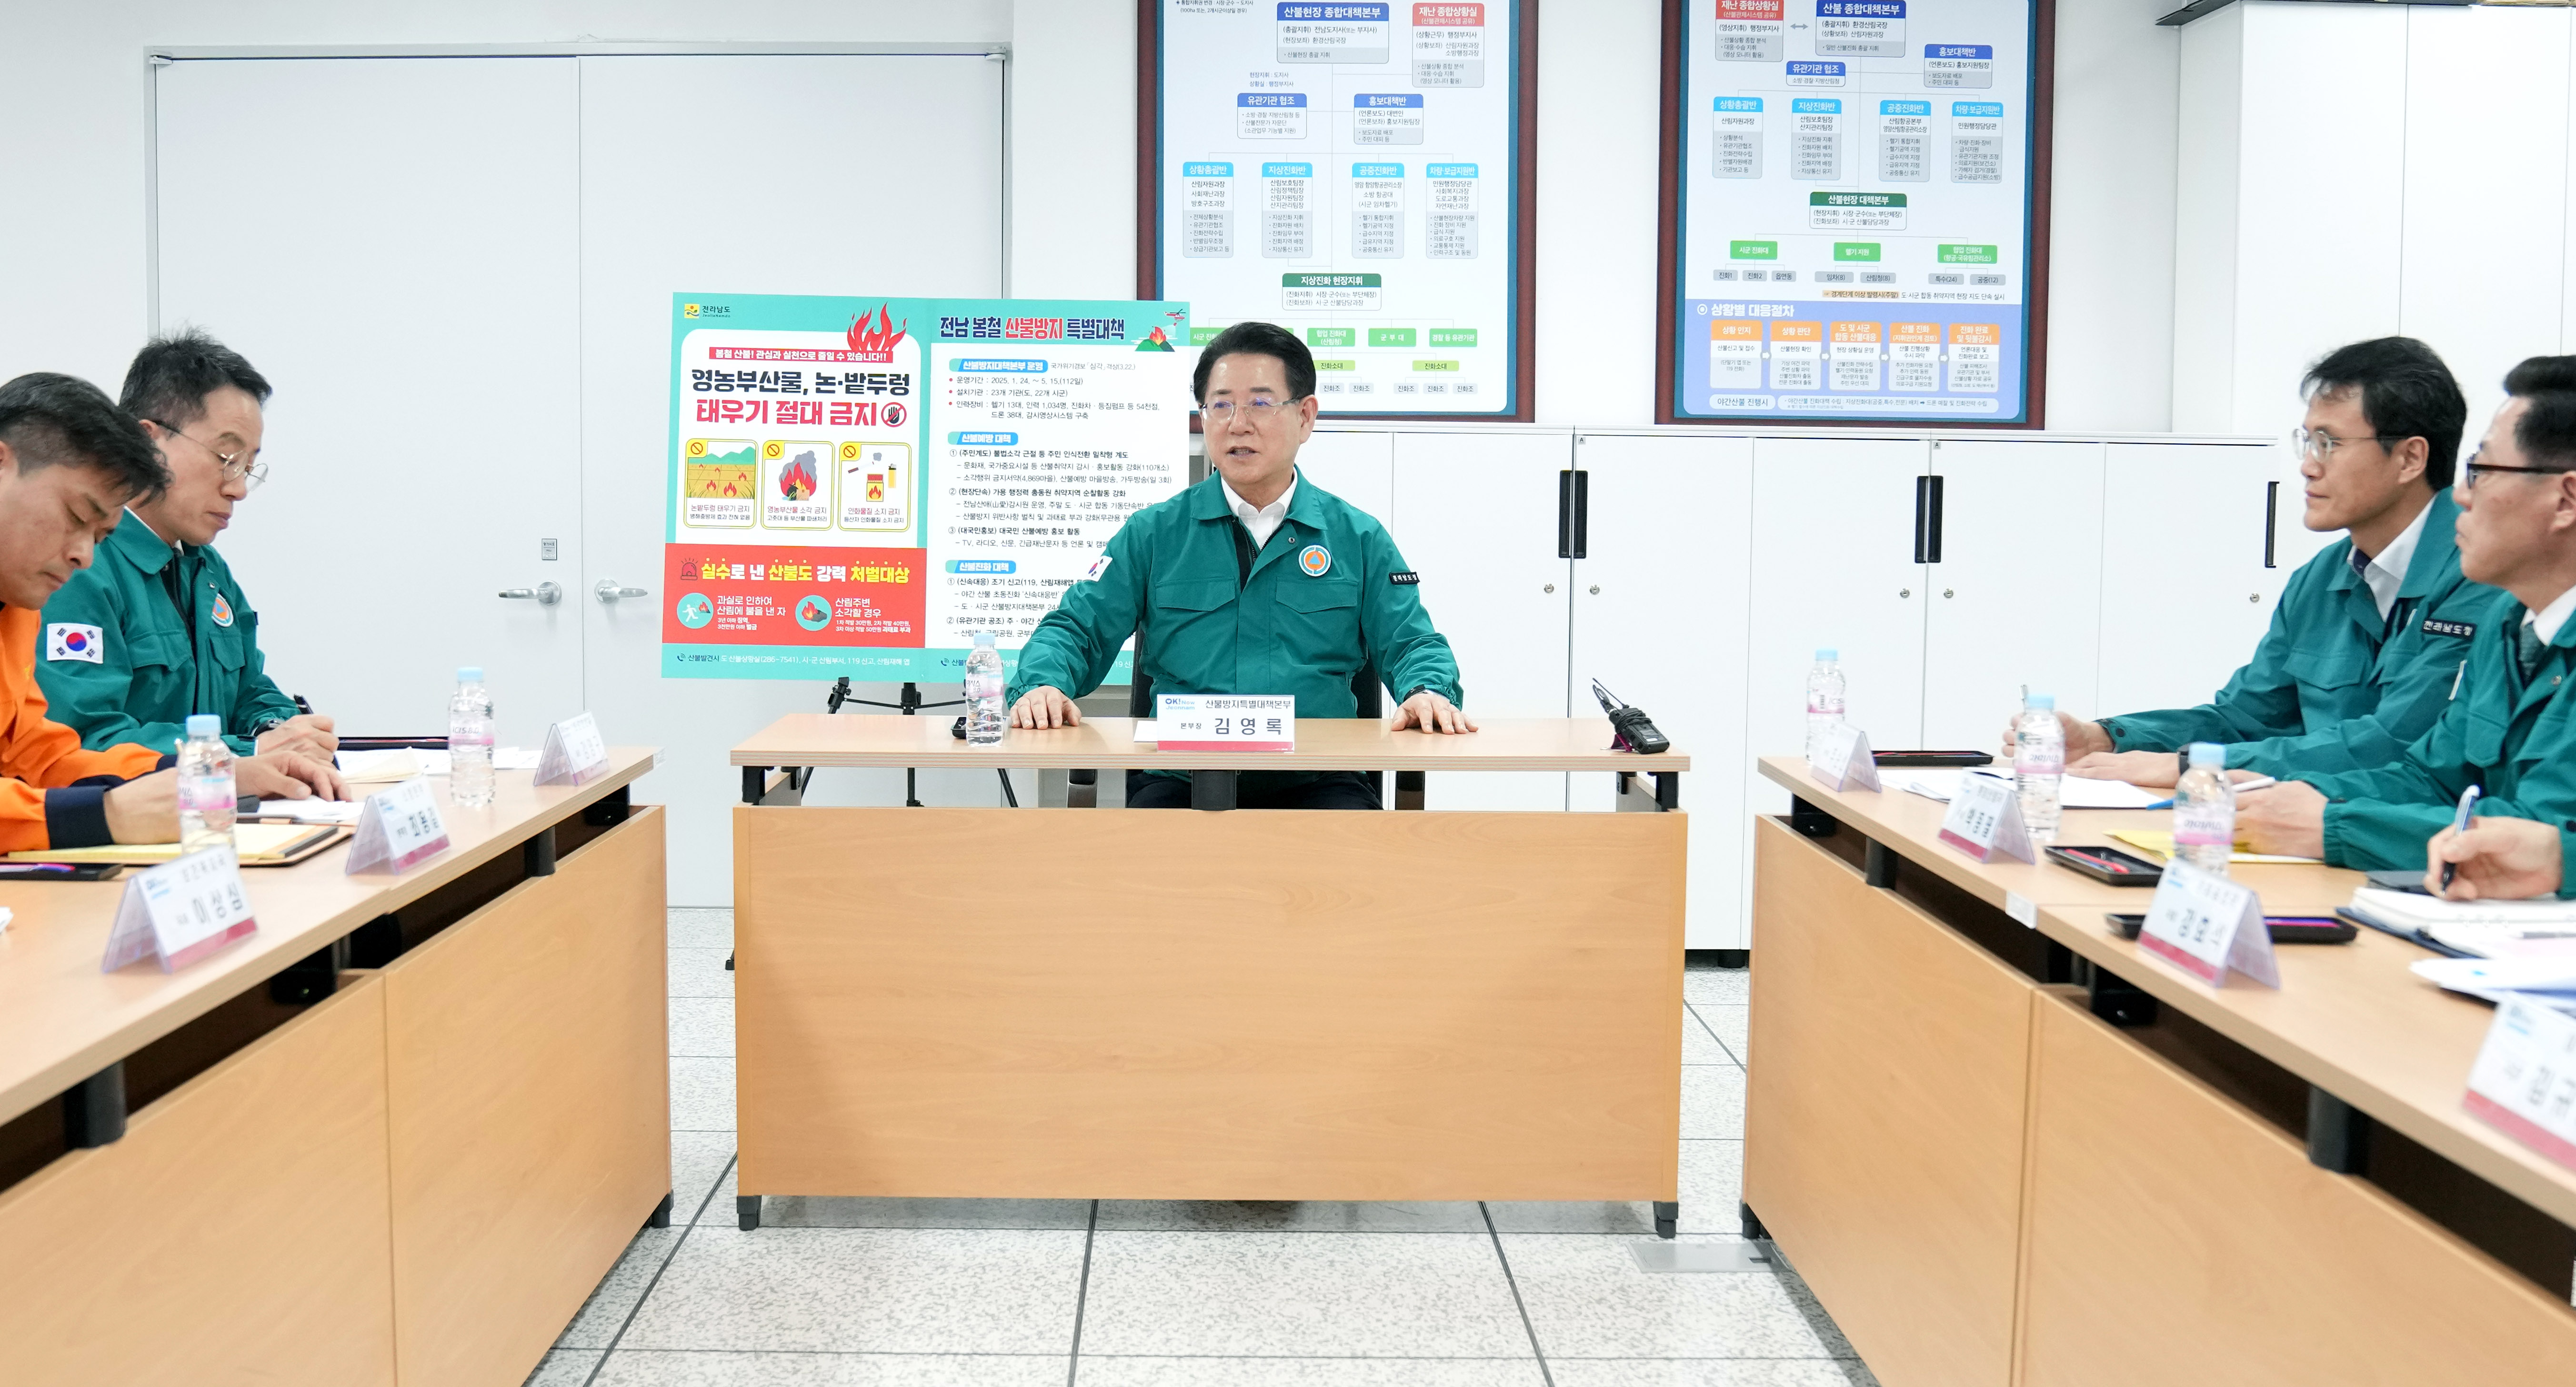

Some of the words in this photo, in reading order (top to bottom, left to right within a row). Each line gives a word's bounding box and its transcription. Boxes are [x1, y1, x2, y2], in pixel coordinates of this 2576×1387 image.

[1721, 1, 1738, 10] 재난
[1739, 1, 1778, 11] 종합상황실
[1823, 4, 1841, 13] 산불
[1845, 4, 1900, 14] 종합대책본부
[1284, 7, 1322, 18] 산불현장
[1324, 7, 1381, 18] 종합대책본부
[1419, 7, 1435, 16] 재난
[1437, 7, 1477, 17] 종합상황실
[1939, 48, 1976, 57] 홍보대책반
[1793, 64, 1822, 73] 유관기관
[1824, 64, 1839, 73] 협조
[1248, 96, 1277, 105] 유관기관
[1280, 96, 1294, 105] 협조
[1369, 97, 1406, 106] 홍보대책반
[1720, 101, 1756, 109] 상황총괄반
[1798, 102, 1835, 111] 지상진화반
[1887, 104, 1924, 113] 공중진화반
[1190, 165, 1227, 174] 상황총괄반
[1269, 166, 1305, 175] 지상진화반
[1360, 166, 1397, 175] 공중진화반
[1828, 195, 1857, 204] 산불현장
[1860, 196, 1889, 205] 대책본부
[1301, 276, 1331, 285] 지상진화
[1333, 277, 1363, 285] 현장지휘
[1711, 304, 1745, 316] 상황별
[1749, 305, 1794, 317] 대응절차
[940, 317, 969, 337] 전남
[973, 317, 1001, 338] 봄철
[1005, 318, 1062, 339] 산불방지
[1067, 318, 1124, 340] 특별대책
[716, 349, 732, 358] 봄철
[734, 350, 753, 359] 산불!
[756, 351, 781, 359] 관심과
[783, 351, 815, 360] 실천으로
[818, 352, 834, 360] 줄일
[836, 352, 844, 361] 수
[847, 352, 886, 362] 있습니다!!
[963, 361, 1025, 371] 산불방지대책본부
[1027, 362, 1043, 371] 운영
[692, 370, 808, 395] 영농부산물,
[816, 372, 909, 395] 논·밭두렁
[697, 400, 768, 423] 태우기
[776, 402, 822, 424] 절대
[830, 402, 876, 426] 금지
[962, 434, 993, 443] 산불예방
[995, 434, 1011, 443] 대책
[960, 563, 991, 571] 산불진화
[993, 563, 1009, 572] 대책
[701, 563, 744, 580] 실수로
[750, 564, 764, 580] 낸
[769, 565, 812, 581] 산불도
[817, 565, 845, 582] 강력
[851, 566, 910, 583] 처벌대상
[717, 596, 743, 605] 과실로
[746, 596, 772, 605] 인하여
[835, 598, 870, 607] 산림주변
[717, 606, 743, 615] 산림에
[745, 607, 763, 615] 불을
[765, 607, 775, 616] 낸
[777, 608, 786, 616] 자
[835, 608, 862, 618] 소각할
[863, 609, 881, 618] 경우
[1206, 700, 1291, 709] 산불방지특별대책본부
